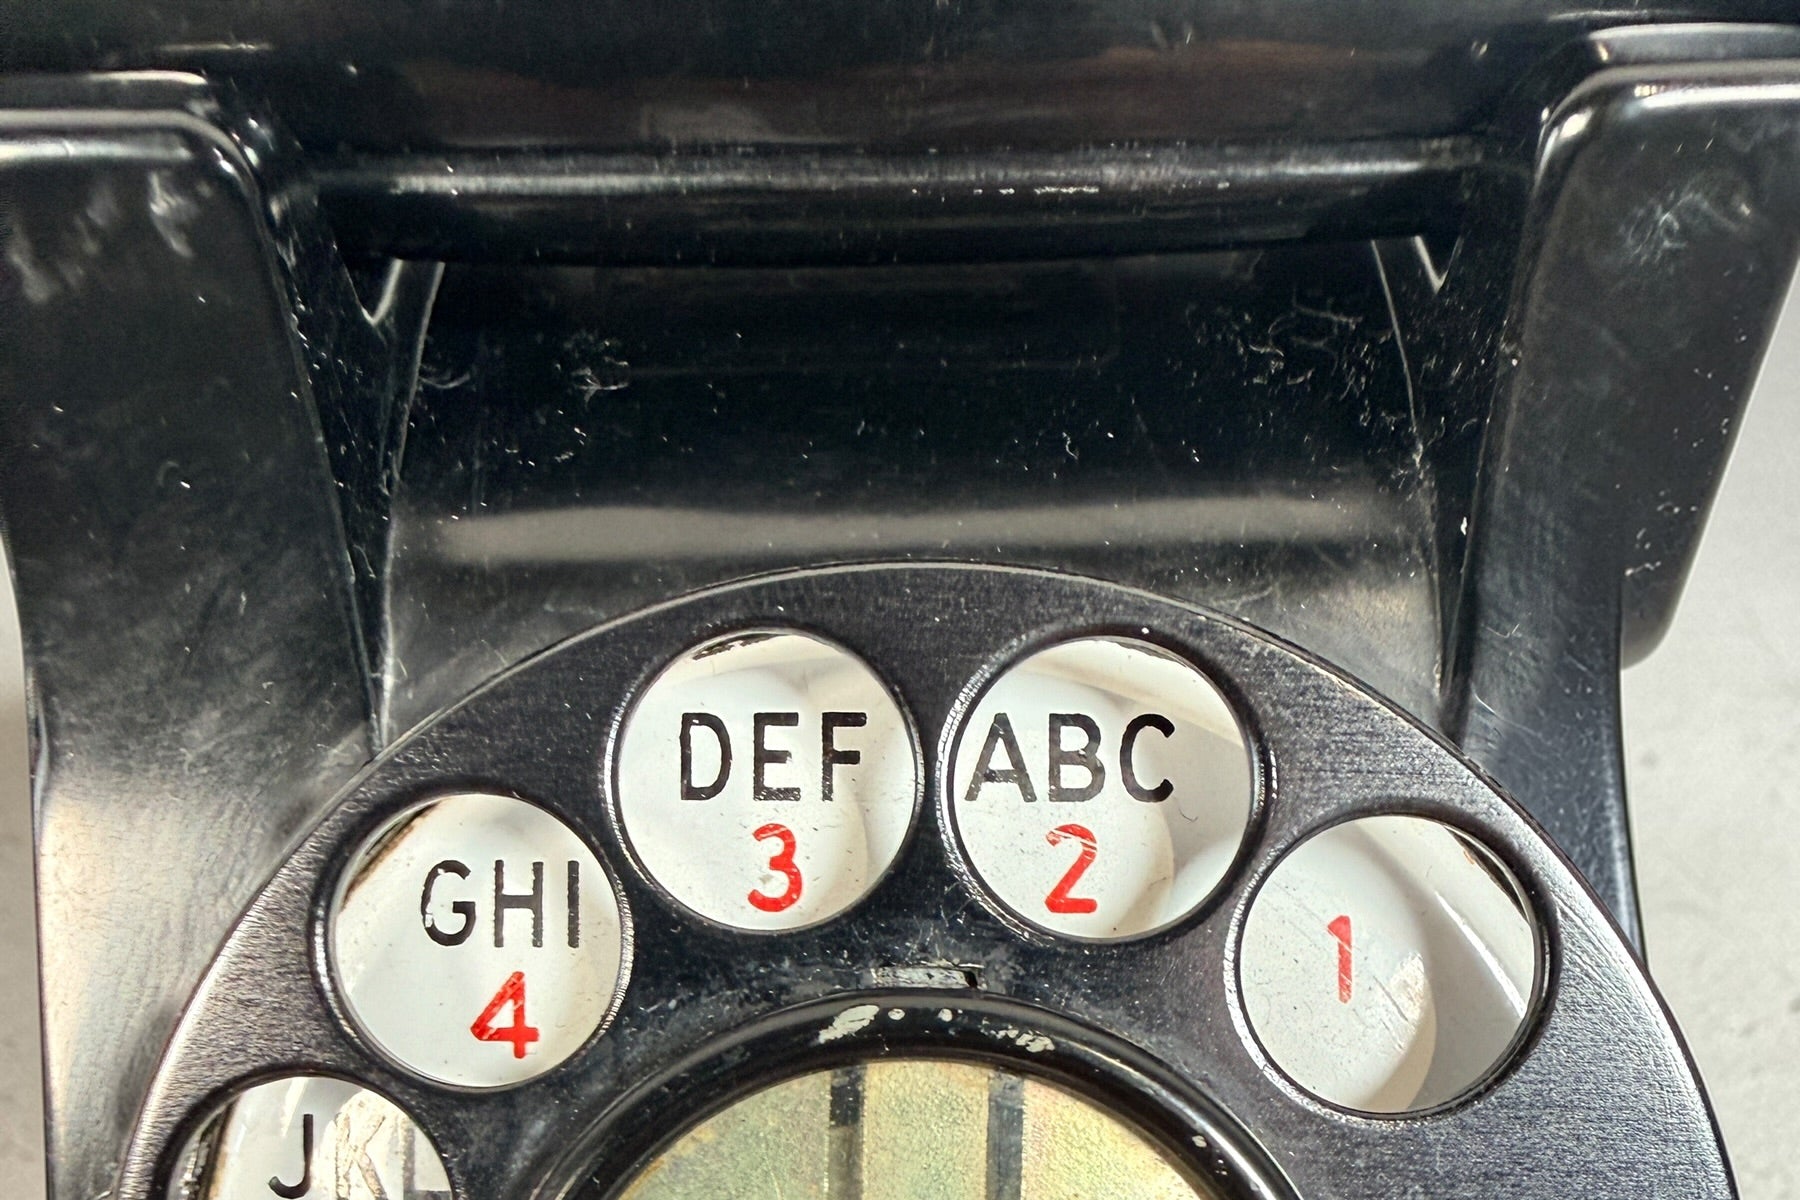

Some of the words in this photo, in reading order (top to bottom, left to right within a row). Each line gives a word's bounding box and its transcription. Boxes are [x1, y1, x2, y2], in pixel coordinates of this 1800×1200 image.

[680, 711, 868, 801] DEF
[964, 712, 1176, 803] ABC
[420, 859, 581, 949] GHI
[747, 823, 803, 912] 3
[1044, 823, 1098, 914] 2
[1327, 915, 1352, 1004] 1
[470, 971, 540, 1060] 4
